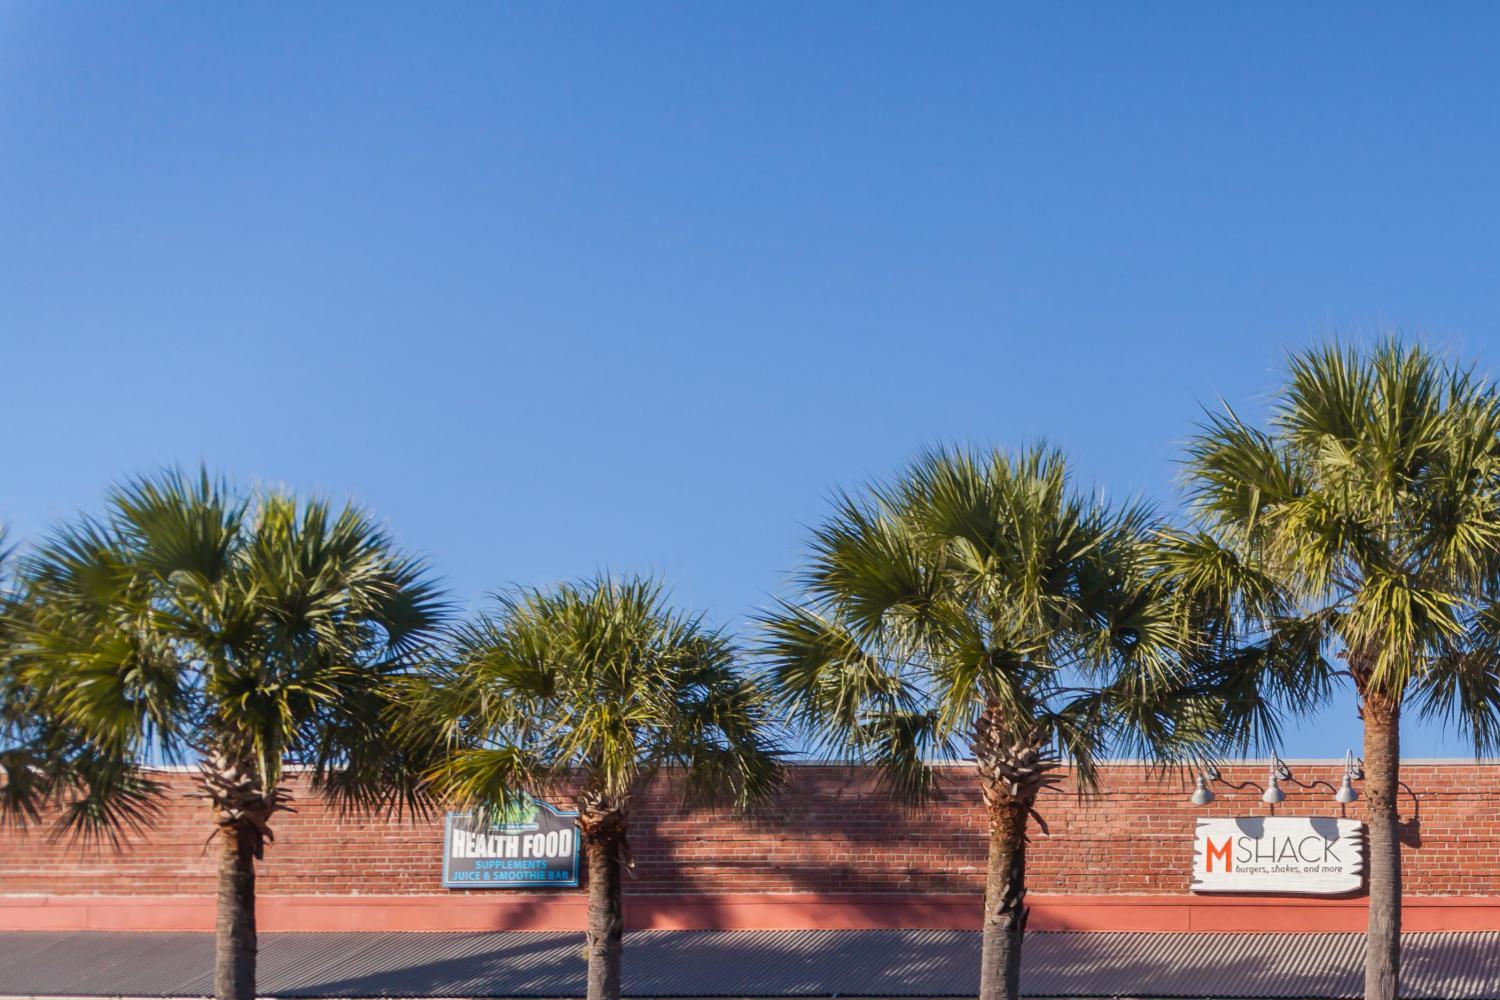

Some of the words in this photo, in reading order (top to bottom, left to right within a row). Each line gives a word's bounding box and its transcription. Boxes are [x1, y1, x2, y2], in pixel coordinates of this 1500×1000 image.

[452, 829, 519, 858] HEALTH
[523, 829, 573, 858] FOOD
[1206, 836, 1232, 872] M
[1236, 836, 1342, 863] SHACK
[475, 860, 548, 870] SUPPLEMENTS
[1236, 864, 1270, 875] burgers,
[1304, 864, 1320, 873] and
[453, 871, 481, 881] JUICE
[483, 871, 490, 881] &
[492, 871, 545, 881] SMOOTHIE
[547, 871, 569, 881] BAR
